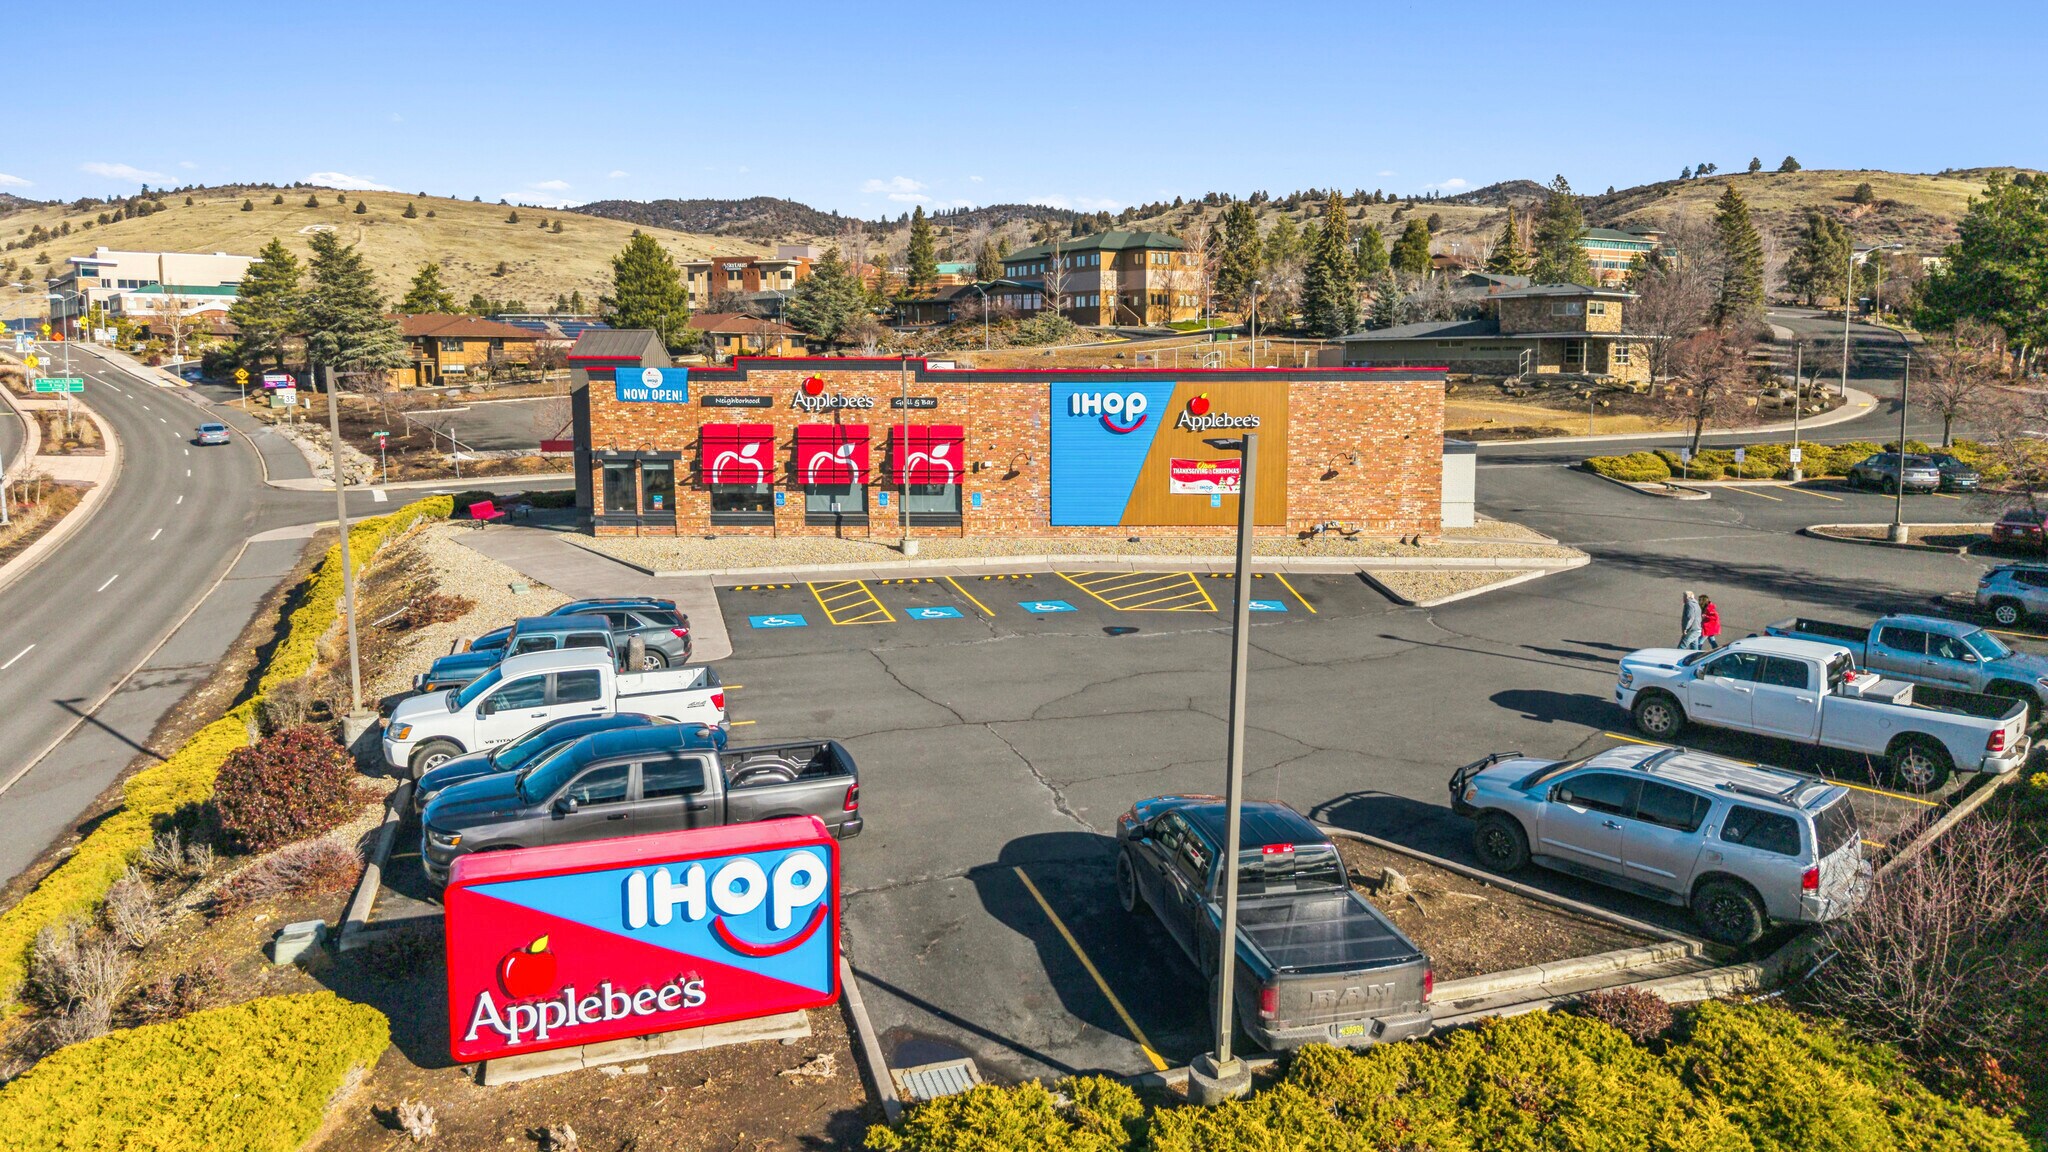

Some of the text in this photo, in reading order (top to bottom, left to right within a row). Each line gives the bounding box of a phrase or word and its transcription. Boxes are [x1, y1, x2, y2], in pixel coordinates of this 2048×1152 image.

[623, 388, 683, 401] NOW OPEN!
[715, 397, 761, 406] Neighborhood
[792, 390, 875, 411] Applebee's
[1072, 392, 1148, 422] IHOP
[1178, 409, 1261, 431] Applebee's
[1197, 461, 1217, 470] Open
[1212, 467, 1240, 475] CHRISTMAS
[627, 850, 829, 930] IHOP
[1310, 982, 1396, 1007] RAM
[464, 977, 707, 1046] Applebee's
